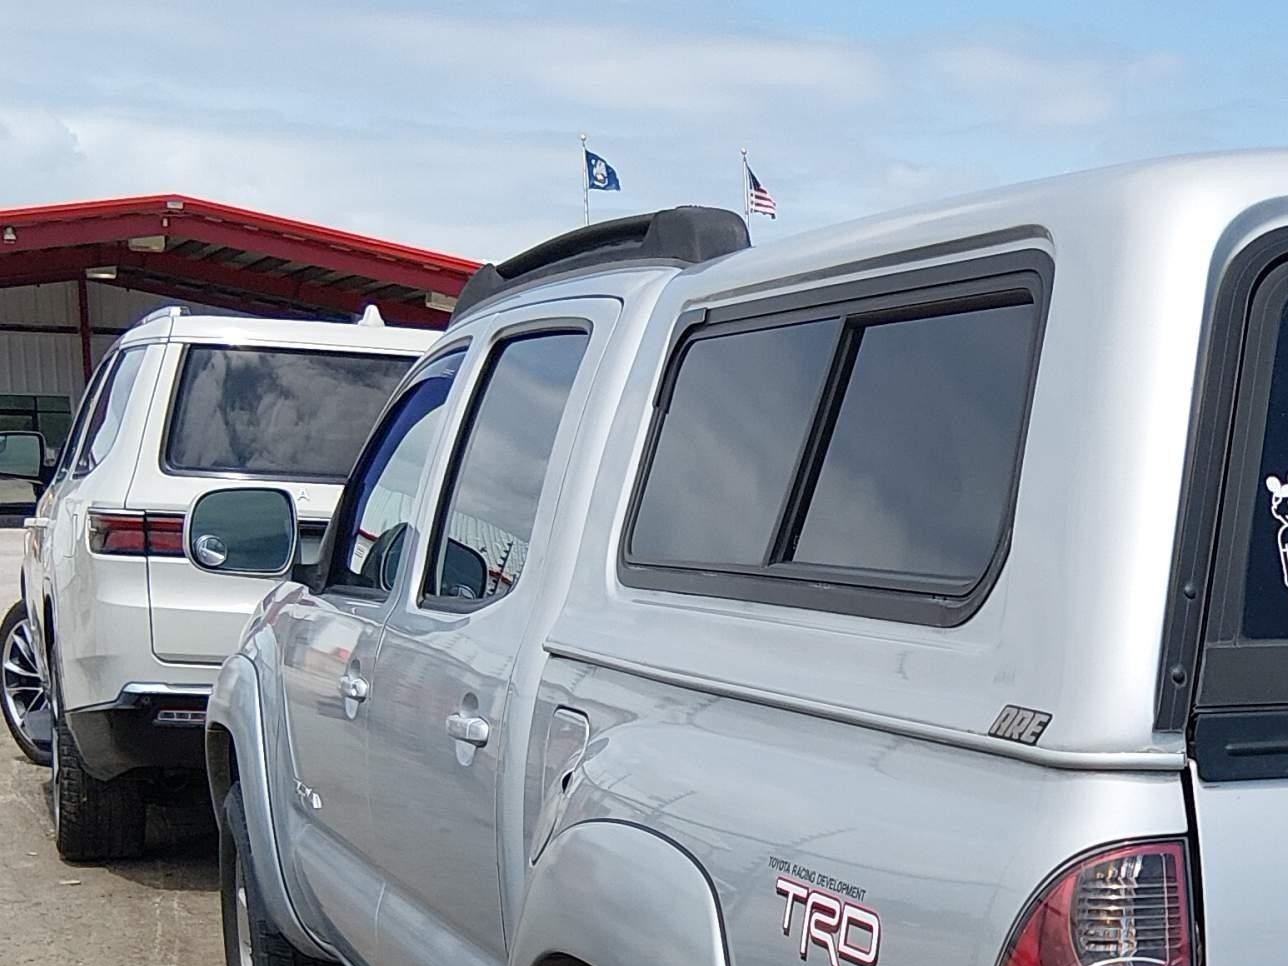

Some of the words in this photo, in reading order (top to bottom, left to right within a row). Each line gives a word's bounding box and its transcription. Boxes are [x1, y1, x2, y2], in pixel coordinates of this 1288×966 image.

[768, 856, 791, 873] TOYOTA
[792, 864, 816, 883] RACING
[816, 873, 866, 901] DEVELOPMENT
